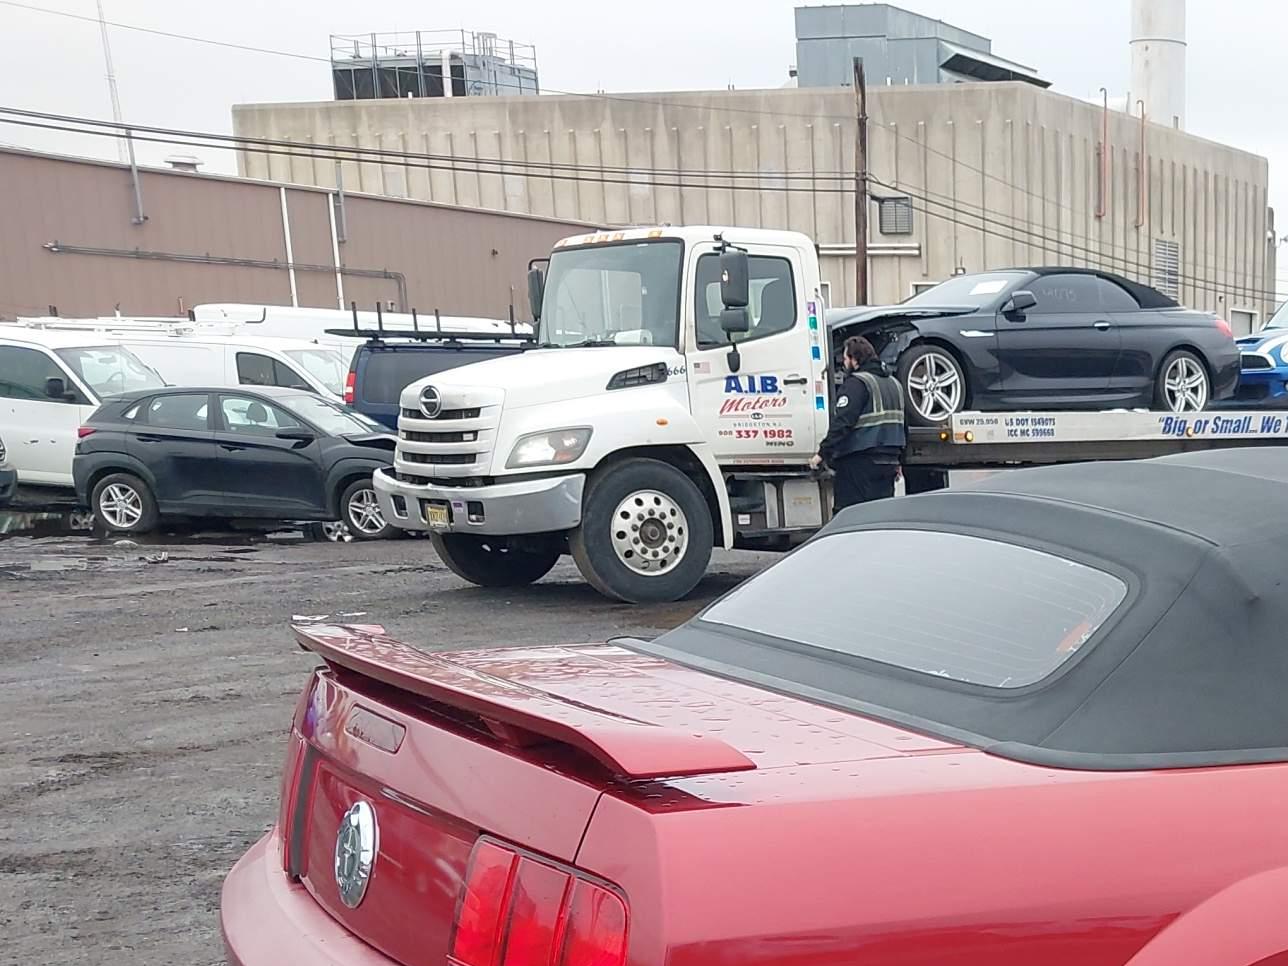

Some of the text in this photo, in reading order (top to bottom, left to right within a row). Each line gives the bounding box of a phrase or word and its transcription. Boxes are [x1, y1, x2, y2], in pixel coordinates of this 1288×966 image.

[724, 375, 783, 394] A.I.B.
[720, 397, 786, 414] Motors
[1004, 418, 1014, 426] US
[1016, 418, 1029, 426] DOT
[1194, 419, 1209, 432] or
[1260, 416, 1281, 433] We
[735, 429, 759, 439] 337
[763, 429, 793, 439] 1982
[1007, 428, 1018, 437] ICC
[1020, 428, 1030, 437] MC
